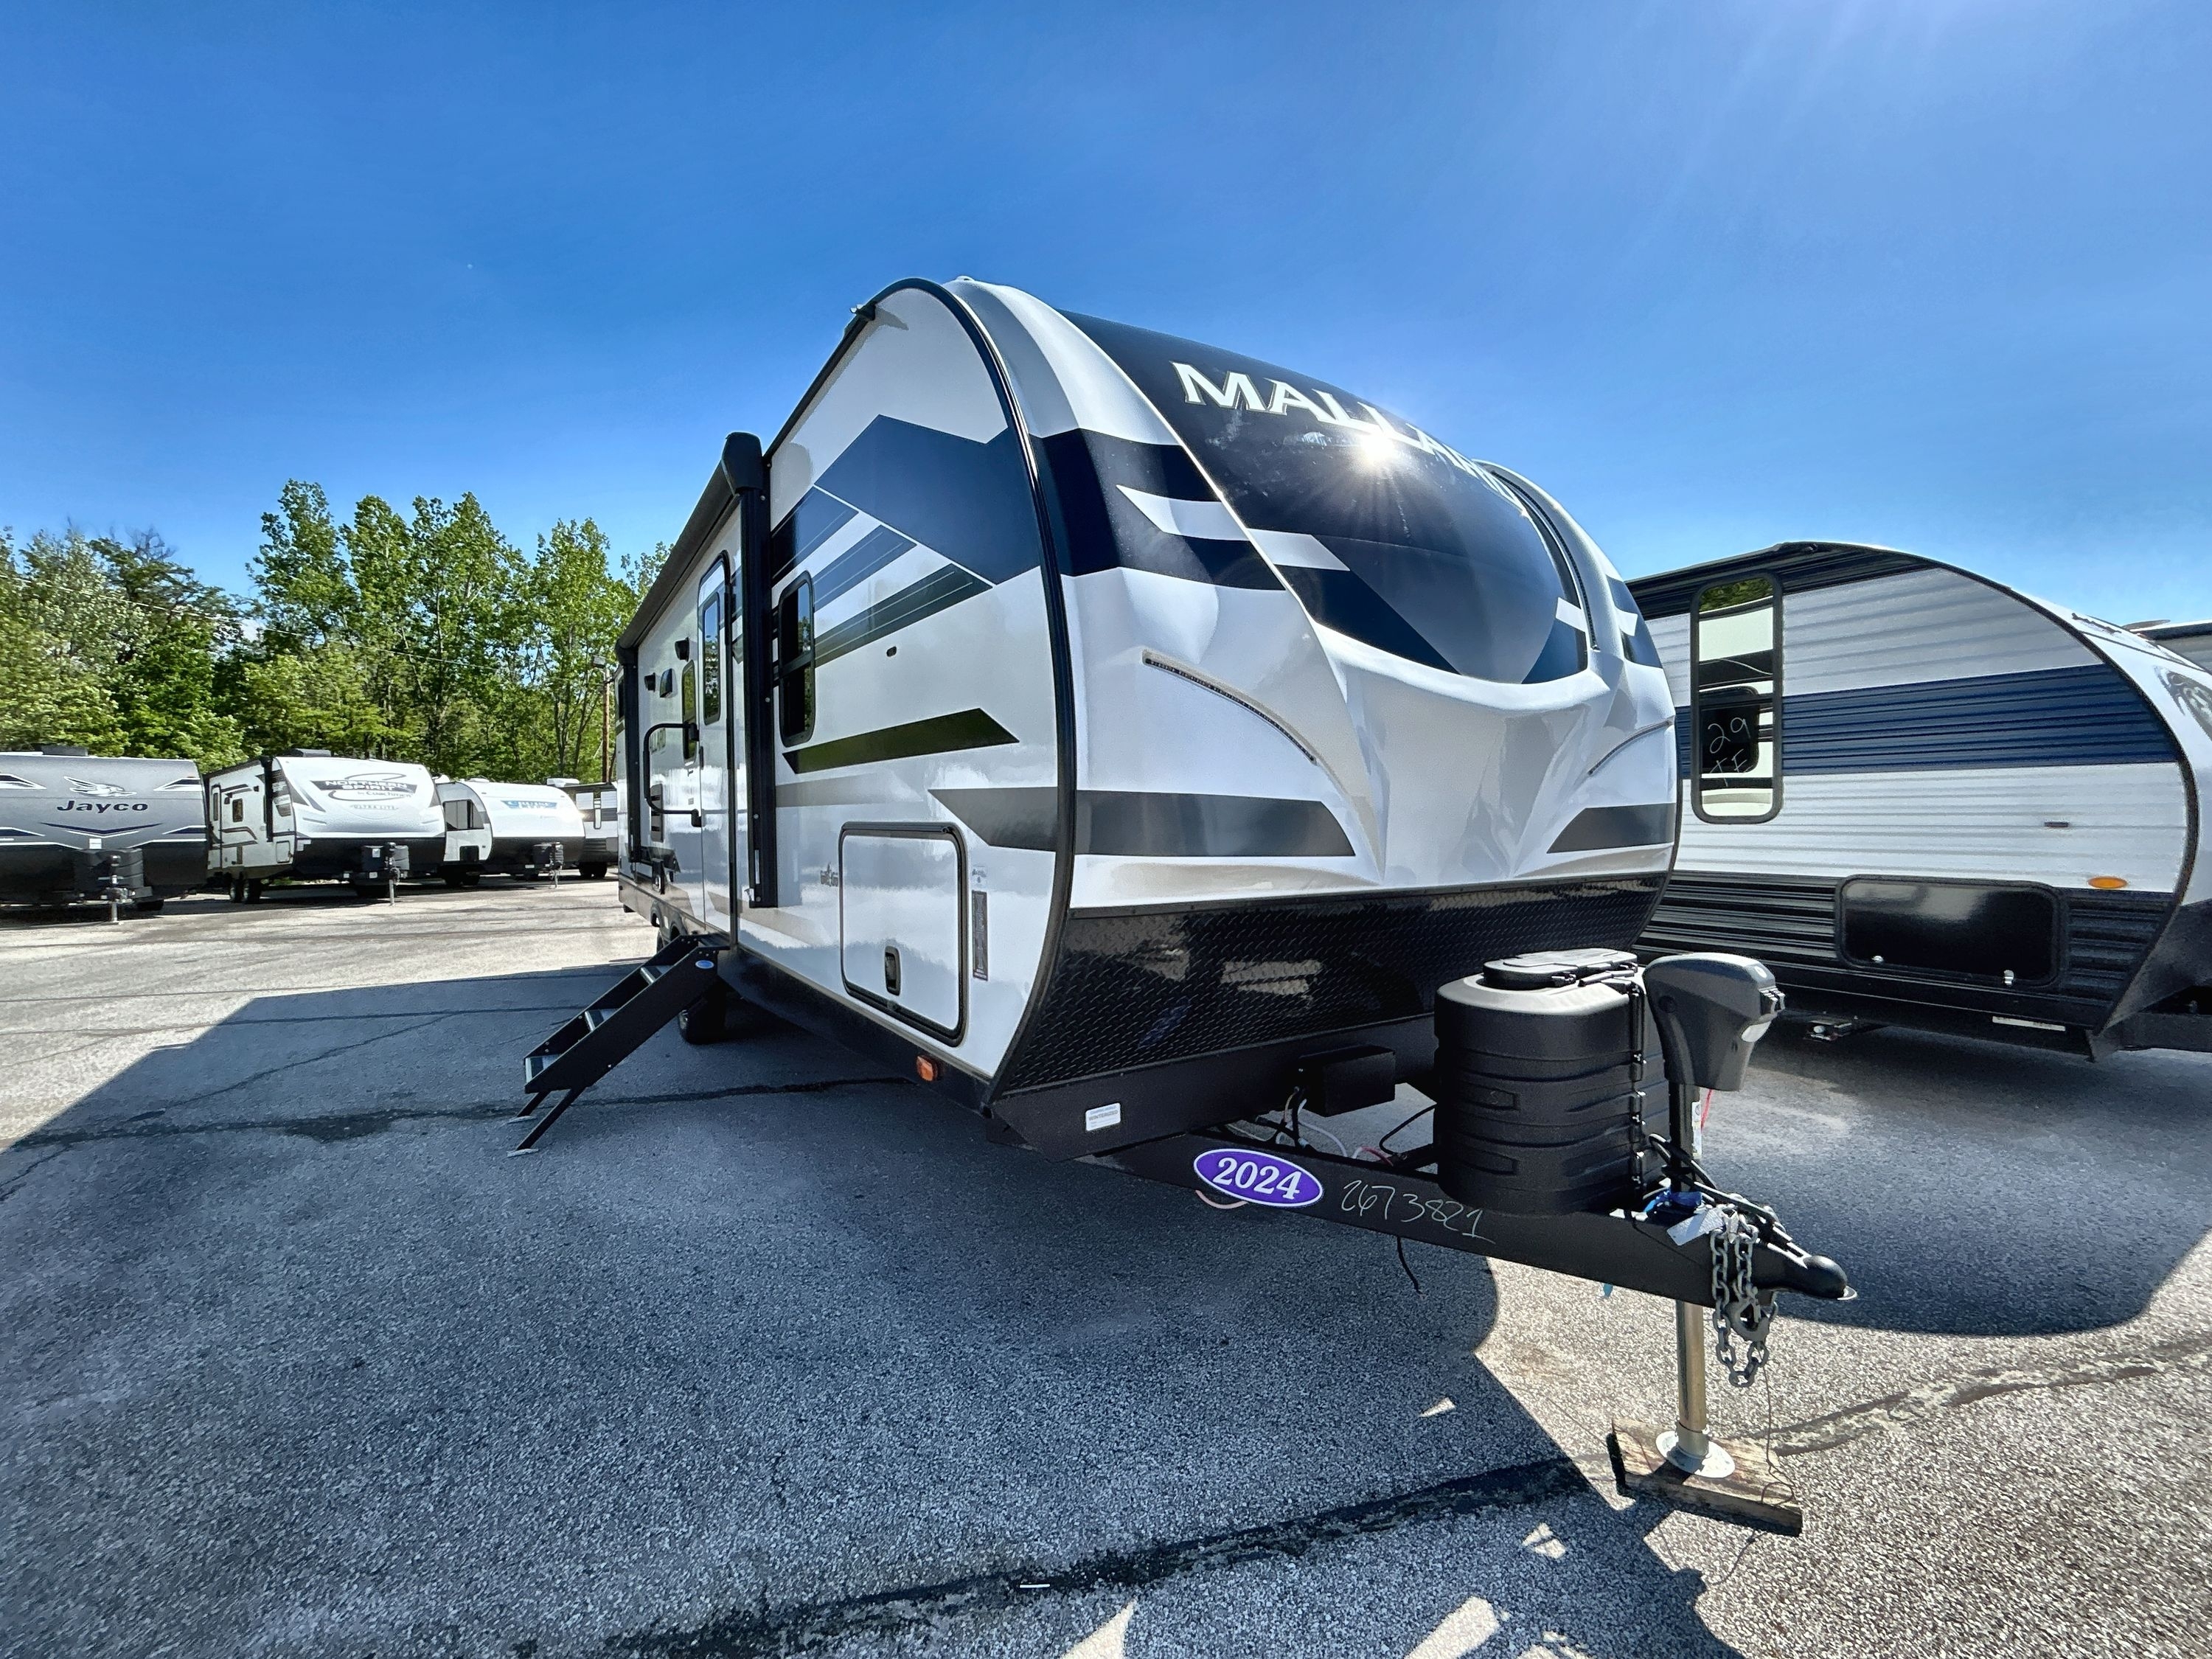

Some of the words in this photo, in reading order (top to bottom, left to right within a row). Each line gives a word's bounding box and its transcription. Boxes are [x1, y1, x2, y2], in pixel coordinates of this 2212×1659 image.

[1171, 361, 1525, 510] MALLA
[1707, 717, 1752, 754] 29
[324, 780, 408, 788] NORTHERN
[56, 800, 148, 813] Jayco
[1212, 1157, 1302, 1200] 2024
